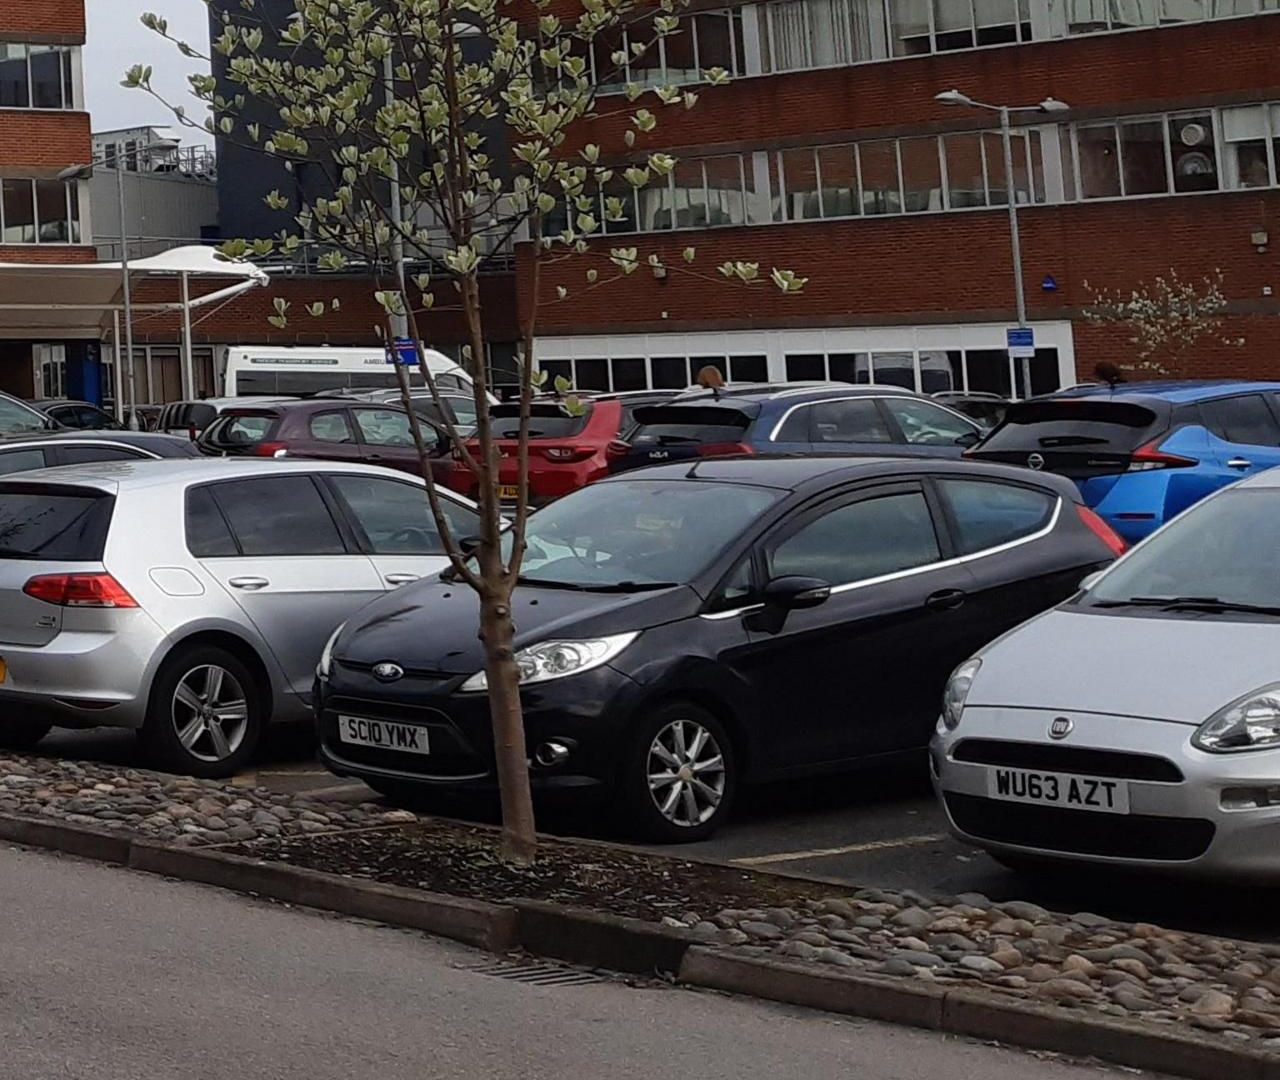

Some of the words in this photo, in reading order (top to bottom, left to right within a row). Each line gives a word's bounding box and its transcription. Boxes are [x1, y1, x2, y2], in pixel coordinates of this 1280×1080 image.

[349, 719, 382, 743] SC10
[385, 724, 419, 749] YMX
[996, 769, 1060, 801] WU63
[1067, 778, 1117, 808] AZT
